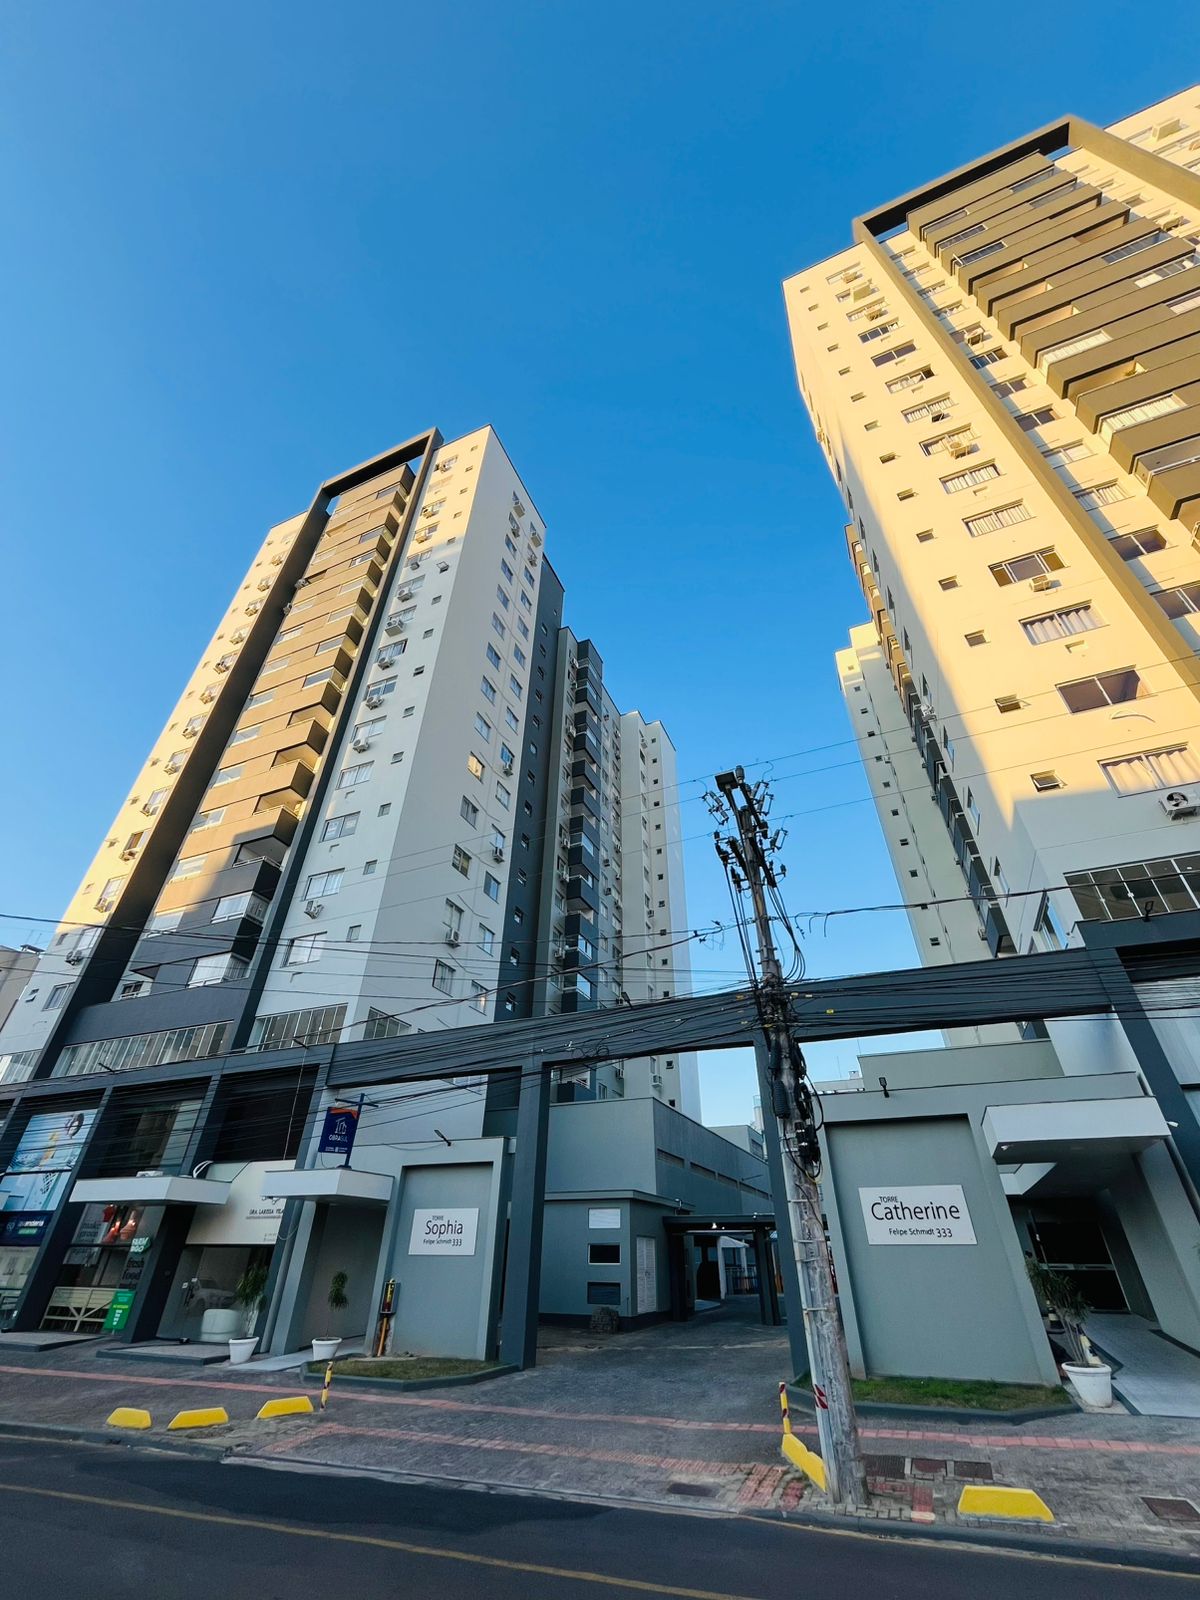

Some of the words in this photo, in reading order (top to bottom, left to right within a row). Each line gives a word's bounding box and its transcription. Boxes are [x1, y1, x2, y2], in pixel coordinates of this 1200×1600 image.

[871, 1201, 961, 1220] Catherine
[425, 1219, 463, 1238] Sophia
[889, 1228, 907, 1236] Felipe
[909, 1228, 934, 1236] Schmidt
[936, 1228, 953, 1238] 333
[452, 1239, 462, 1247] 333
